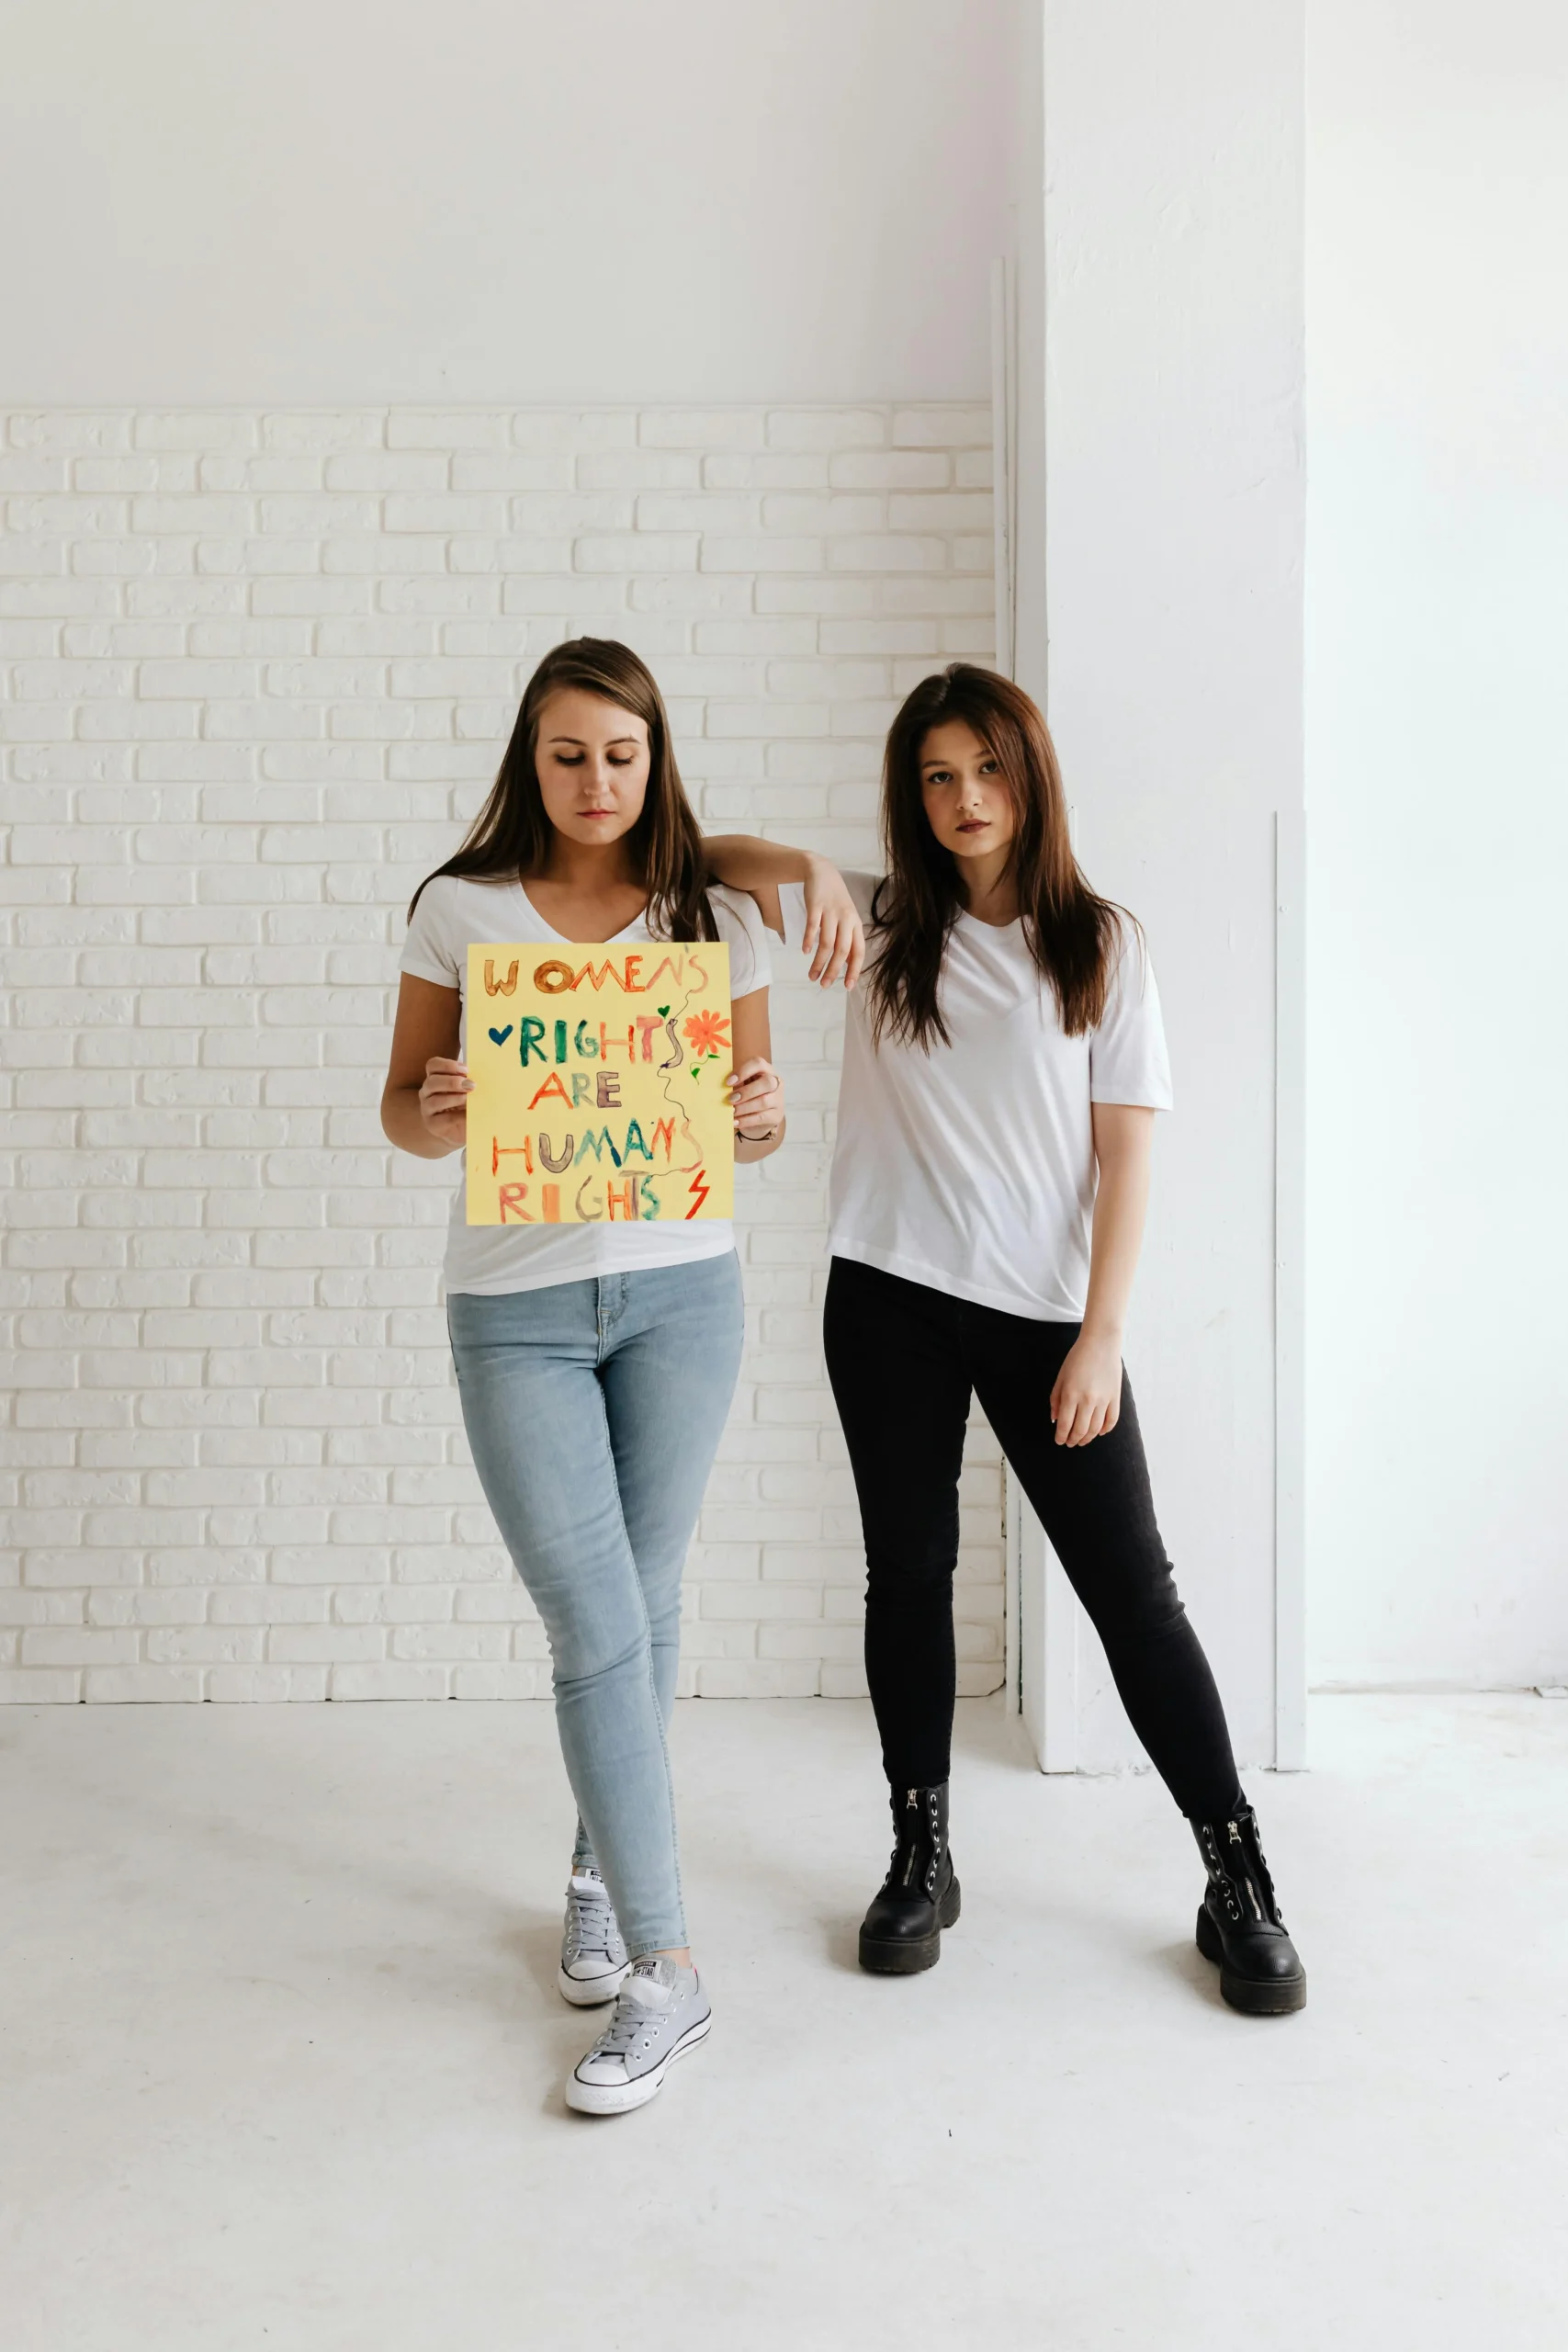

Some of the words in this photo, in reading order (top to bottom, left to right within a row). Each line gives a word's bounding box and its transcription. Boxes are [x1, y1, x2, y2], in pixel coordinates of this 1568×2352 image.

[519, 1015, 683, 1069] RIGHTS
[527, 1071, 622, 1110] ARE
[499, 1170, 660, 1224] RIGHTS
